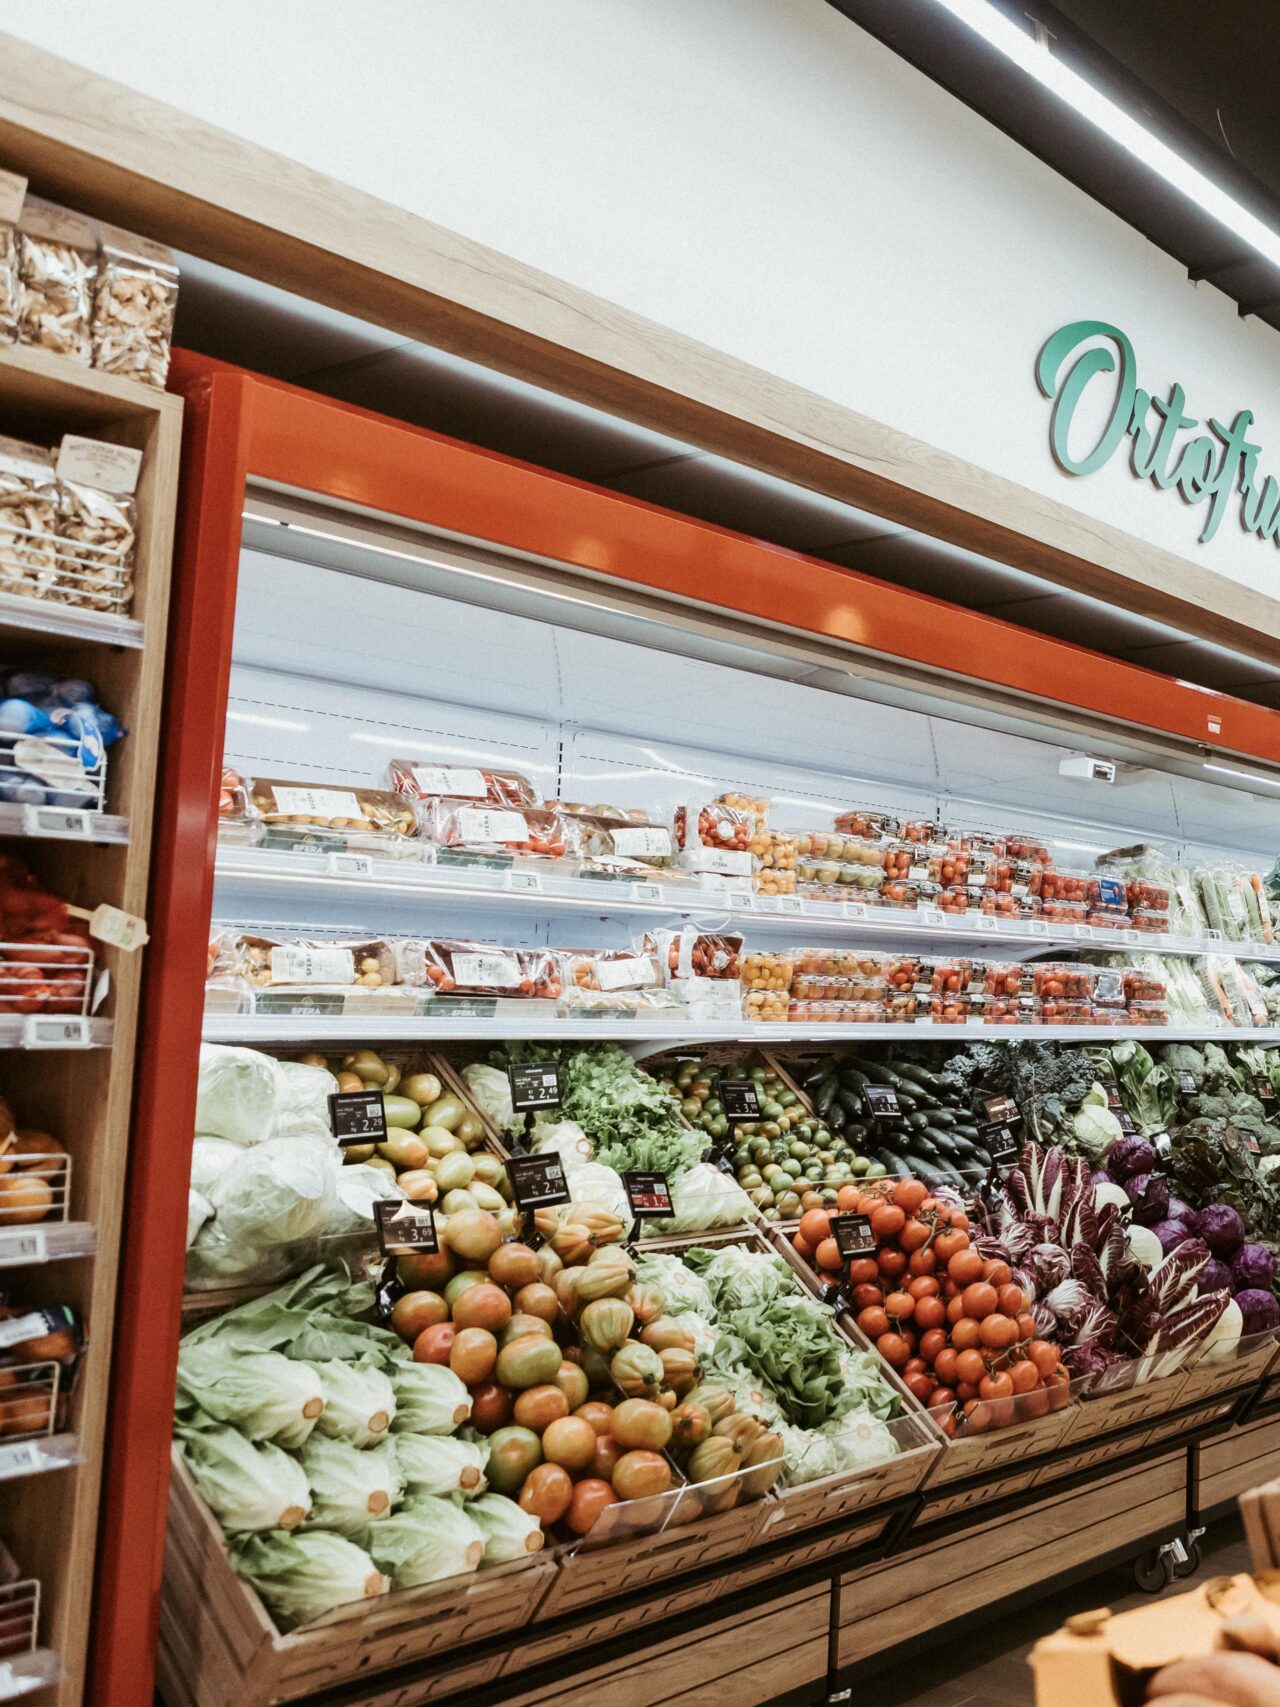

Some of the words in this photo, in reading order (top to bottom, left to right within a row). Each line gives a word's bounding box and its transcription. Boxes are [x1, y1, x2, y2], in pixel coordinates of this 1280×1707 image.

[293, 844, 323, 854] SFERA
[291, 1007, 321, 1015] SFERA
[539, 1087, 557, 1099] 2,49
[362, 1118, 383, 1132] 2,29
[543, 1179, 564, 1194] 2,79
[411, 1228, 432, 1241] 3,69
